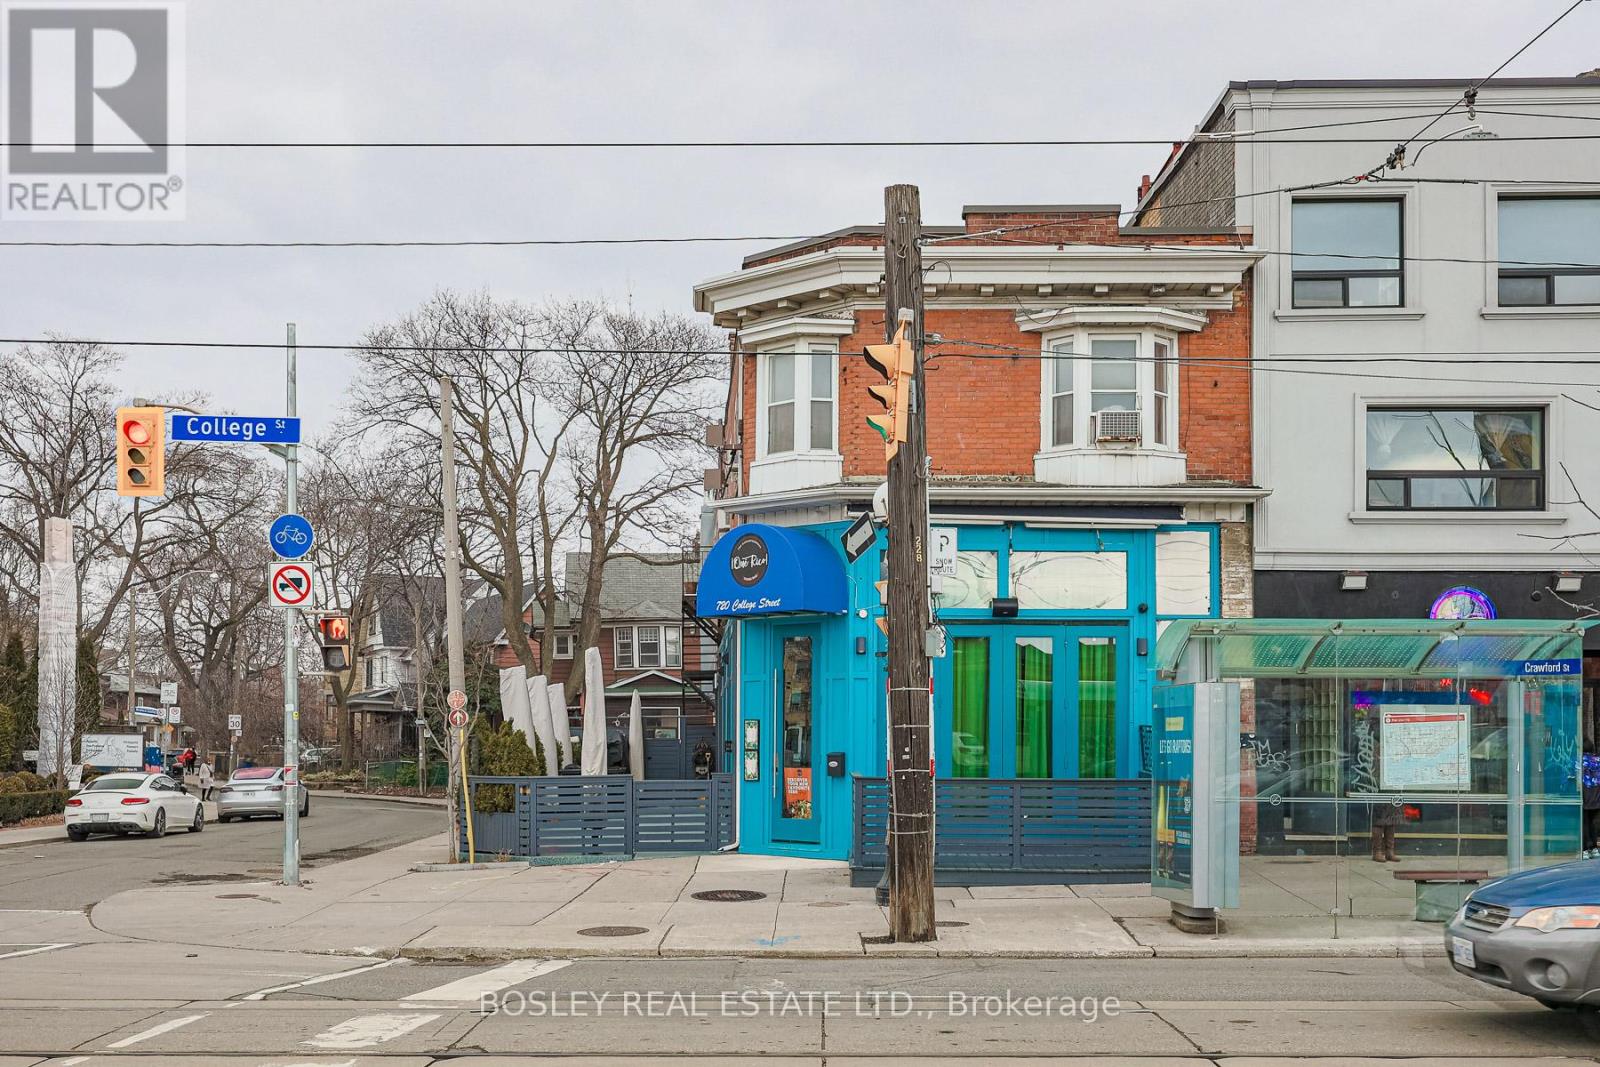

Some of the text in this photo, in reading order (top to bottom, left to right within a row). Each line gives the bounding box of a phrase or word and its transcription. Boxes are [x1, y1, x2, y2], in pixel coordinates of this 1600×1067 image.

[186, 417, 267, 440] College
[716, 597, 781, 612] 720 College Street
[1524, 662, 1570, 673] Crawford St
[230, 720, 240, 728] 30
